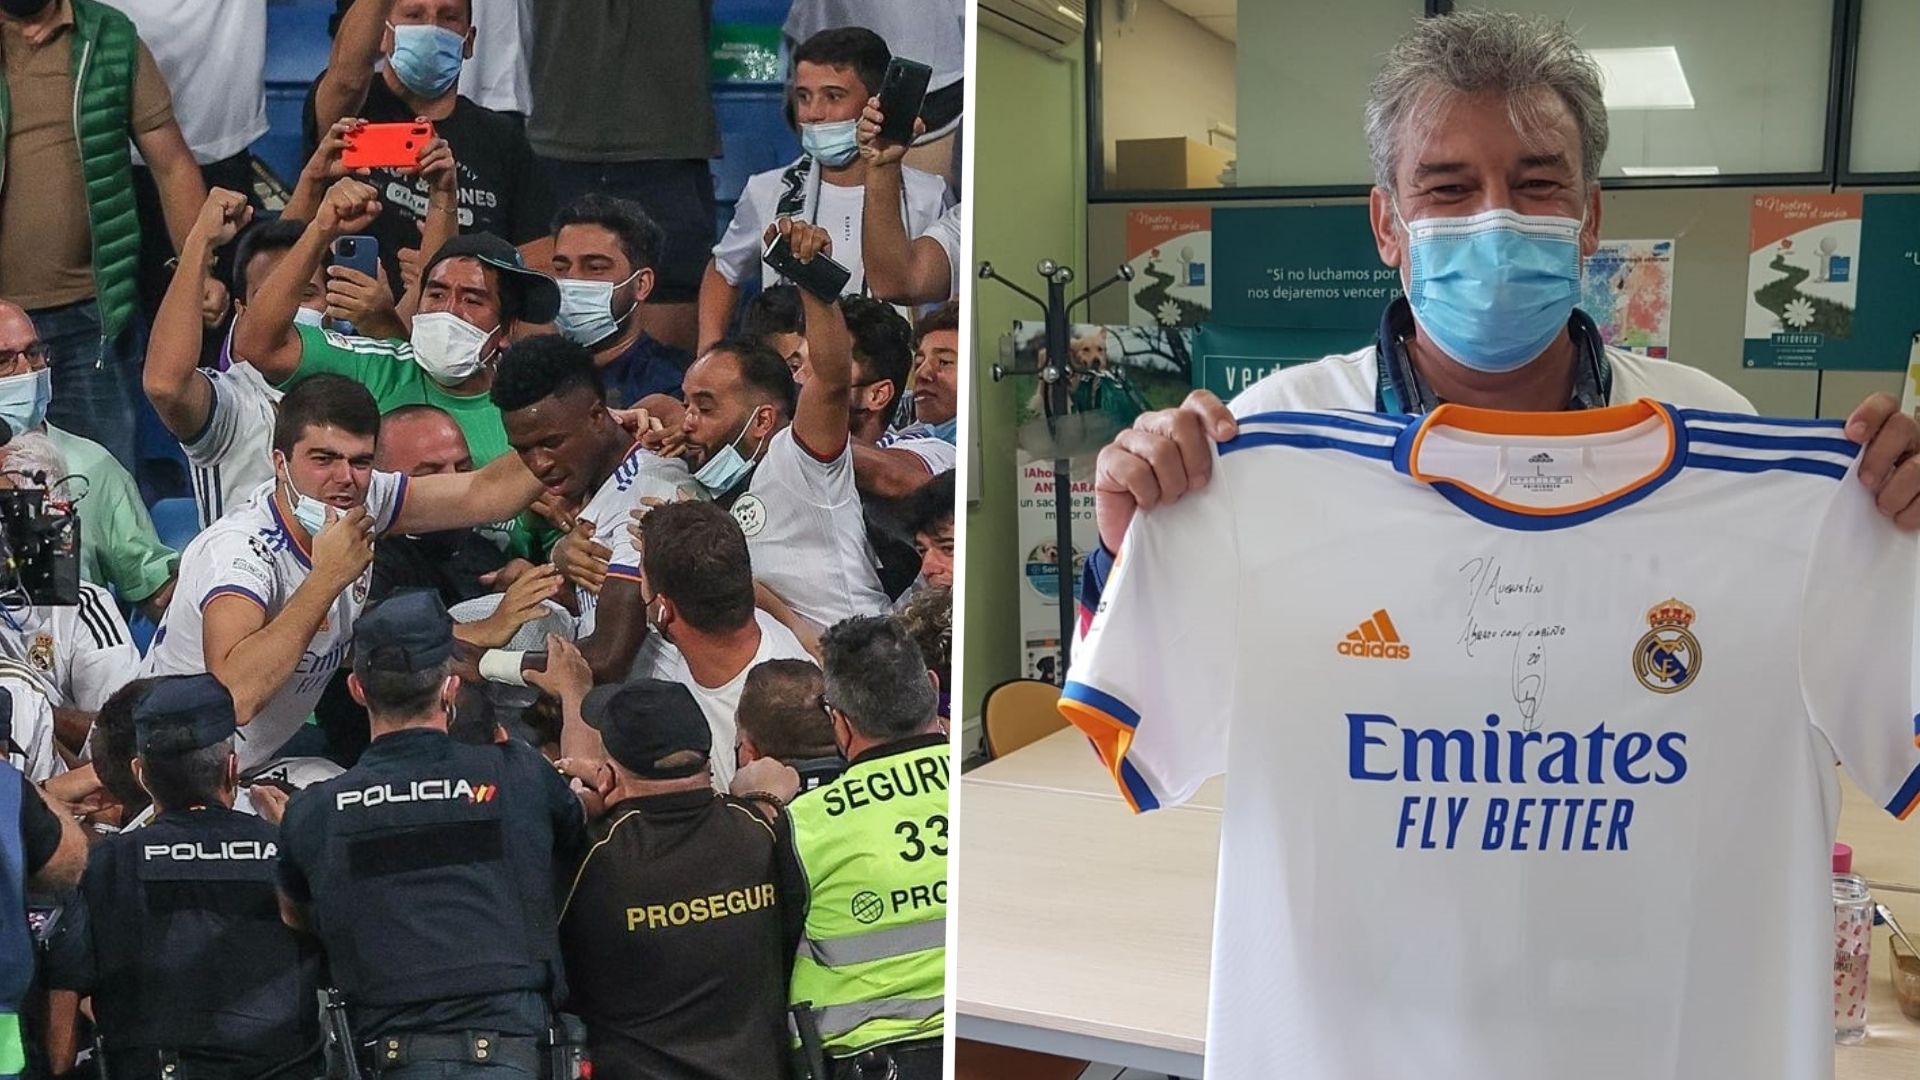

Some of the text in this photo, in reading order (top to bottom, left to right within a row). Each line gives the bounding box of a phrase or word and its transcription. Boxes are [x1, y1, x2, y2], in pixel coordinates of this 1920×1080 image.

[456, 188, 497, 208] NES
[1287, 270, 1305, 281] no
[1308, 267, 1370, 281] luchamos
[1373, 269, 1397, 282] por
[1247, 288, 1270, 299] nos
[1272, 285, 1340, 301] dejaremos
[1343, 287, 1386, 299] vencer
[1036, 498, 1057, 508] sac
[1336, 640, 1411, 660] adidas
[1344, 713, 1689, 785] Emirates
[336, 779, 475, 811] POLICIA
[823, 755, 950, 816] SEGURI
[1395, 796, 1636, 851] FLY BETTER
[144, 841, 279, 861] POLICIA
[626, 883, 776, 932] PROSEGUR
